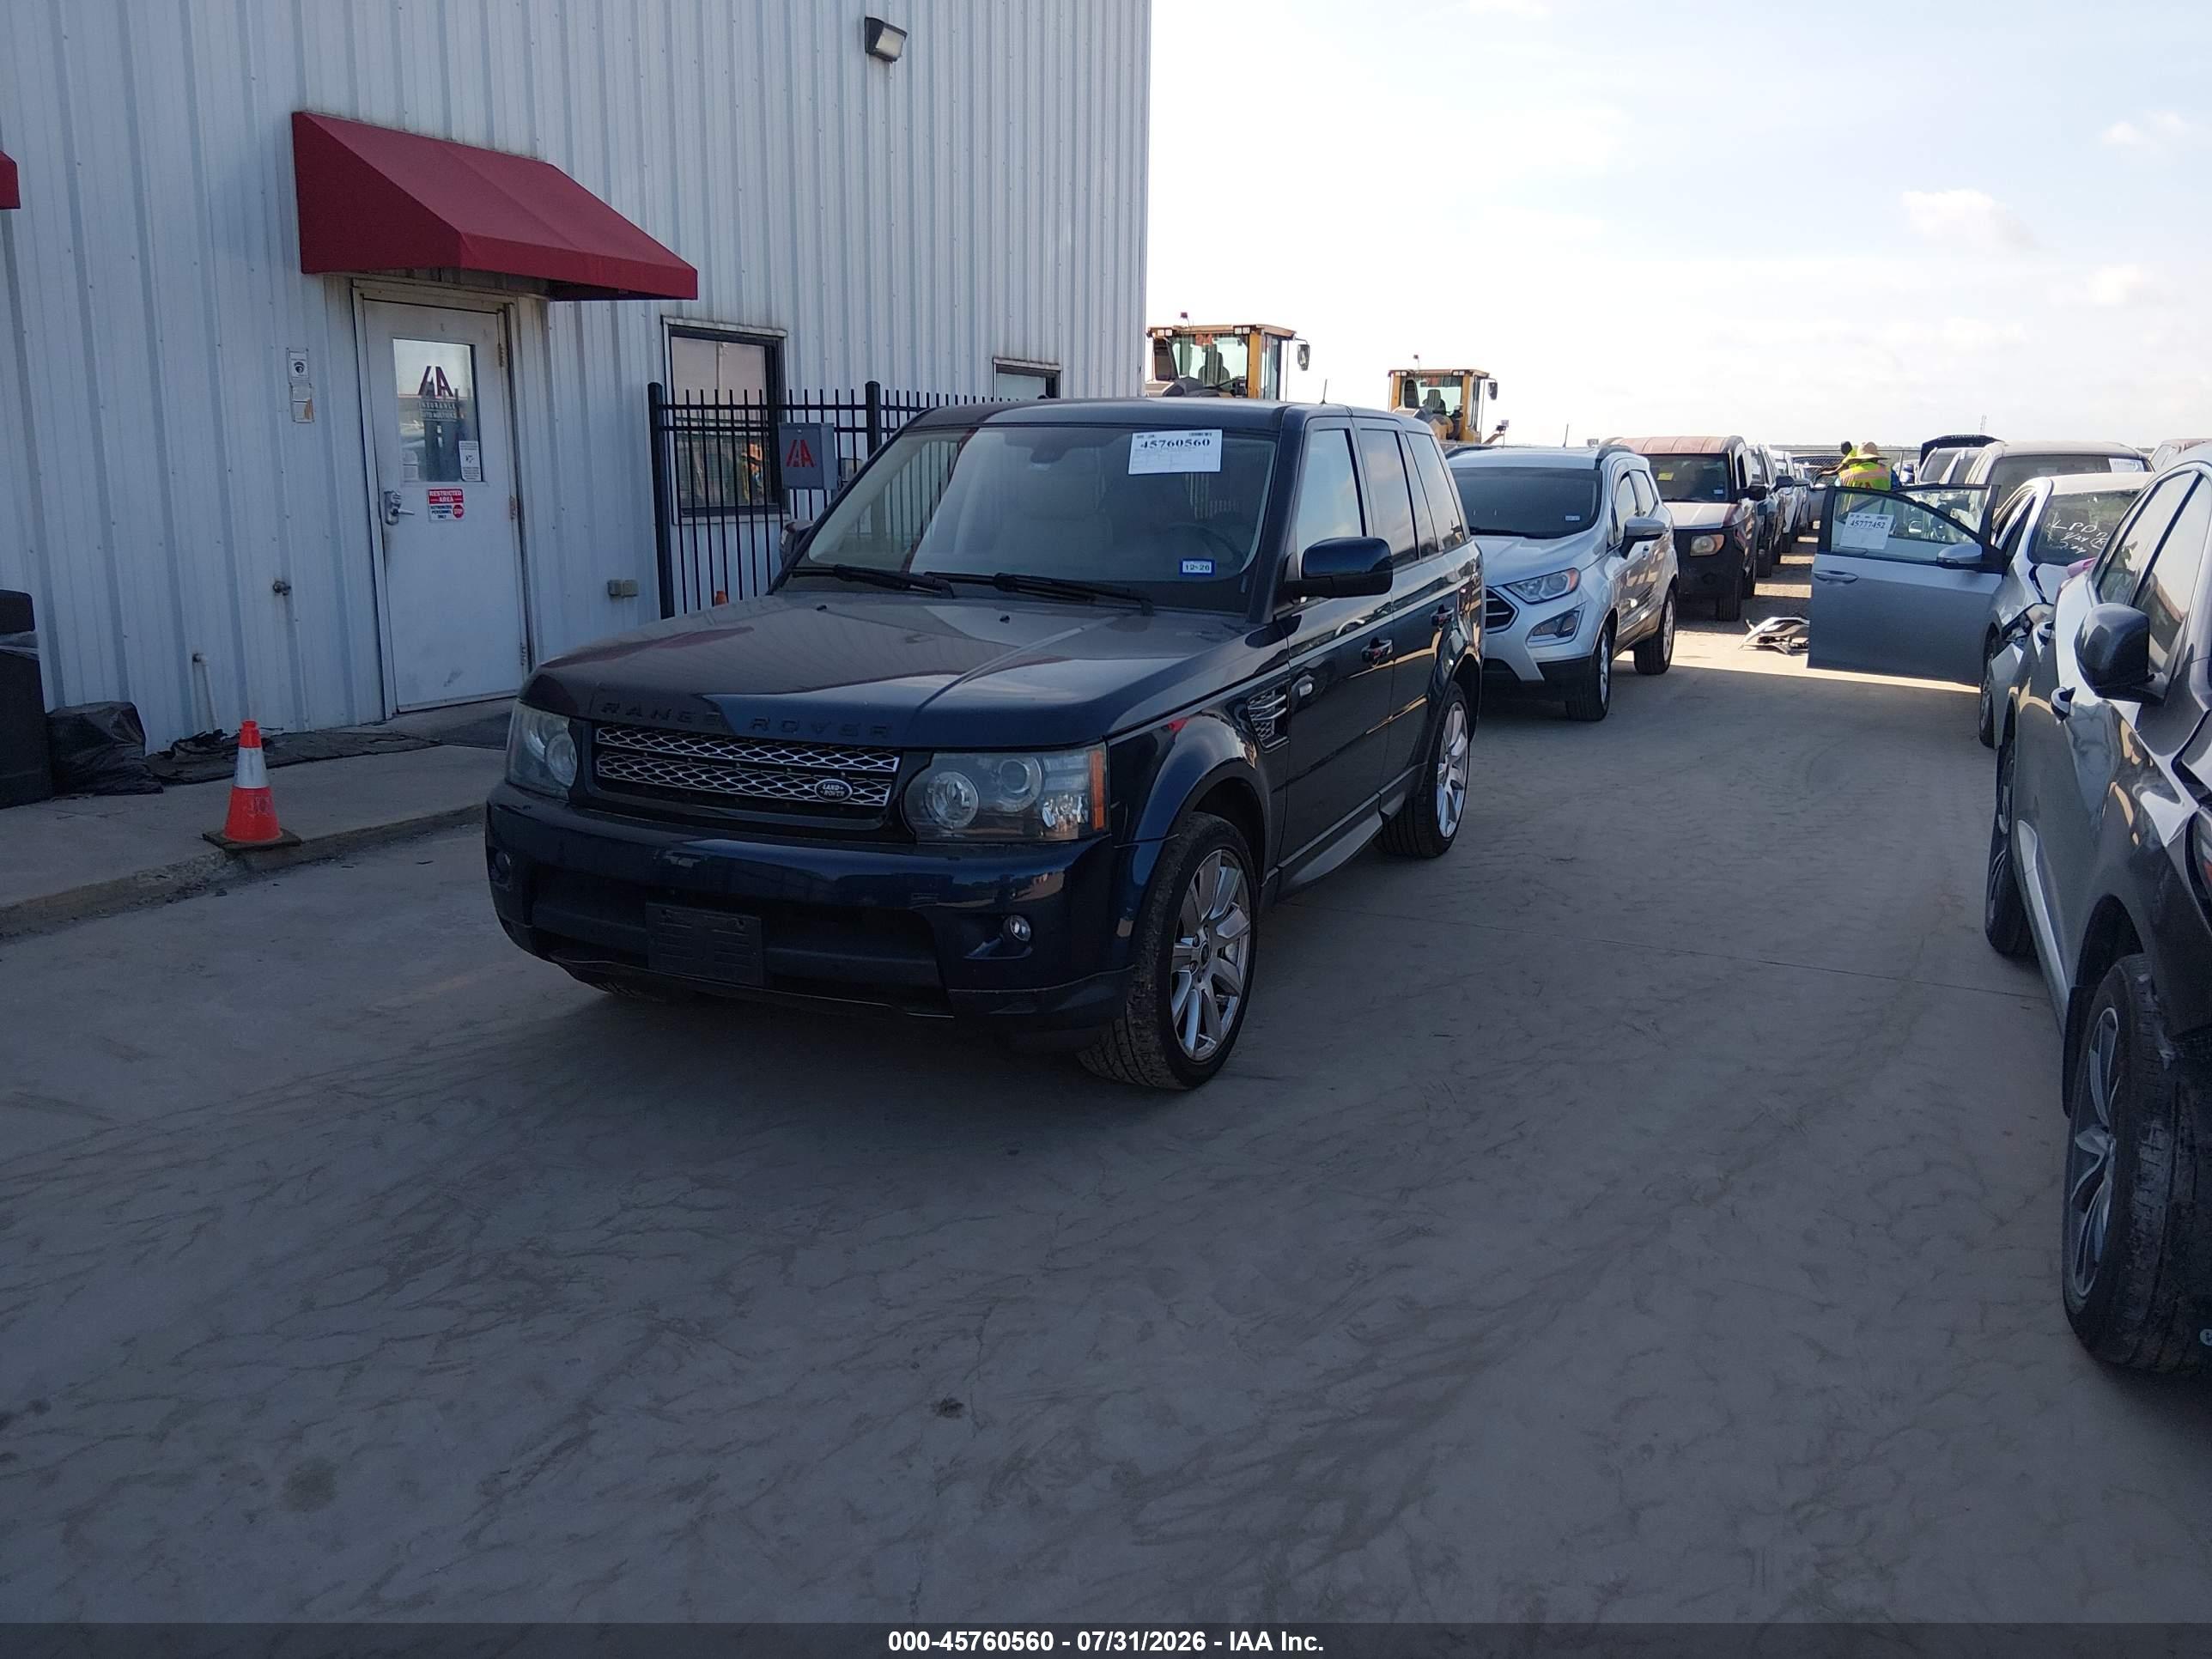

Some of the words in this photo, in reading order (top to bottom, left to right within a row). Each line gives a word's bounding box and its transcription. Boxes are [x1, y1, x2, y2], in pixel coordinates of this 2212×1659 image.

[1139, 438, 1210, 448] 45760560
[600, 702, 724, 727] RANGE
[749, 716, 893, 738] ROVER
